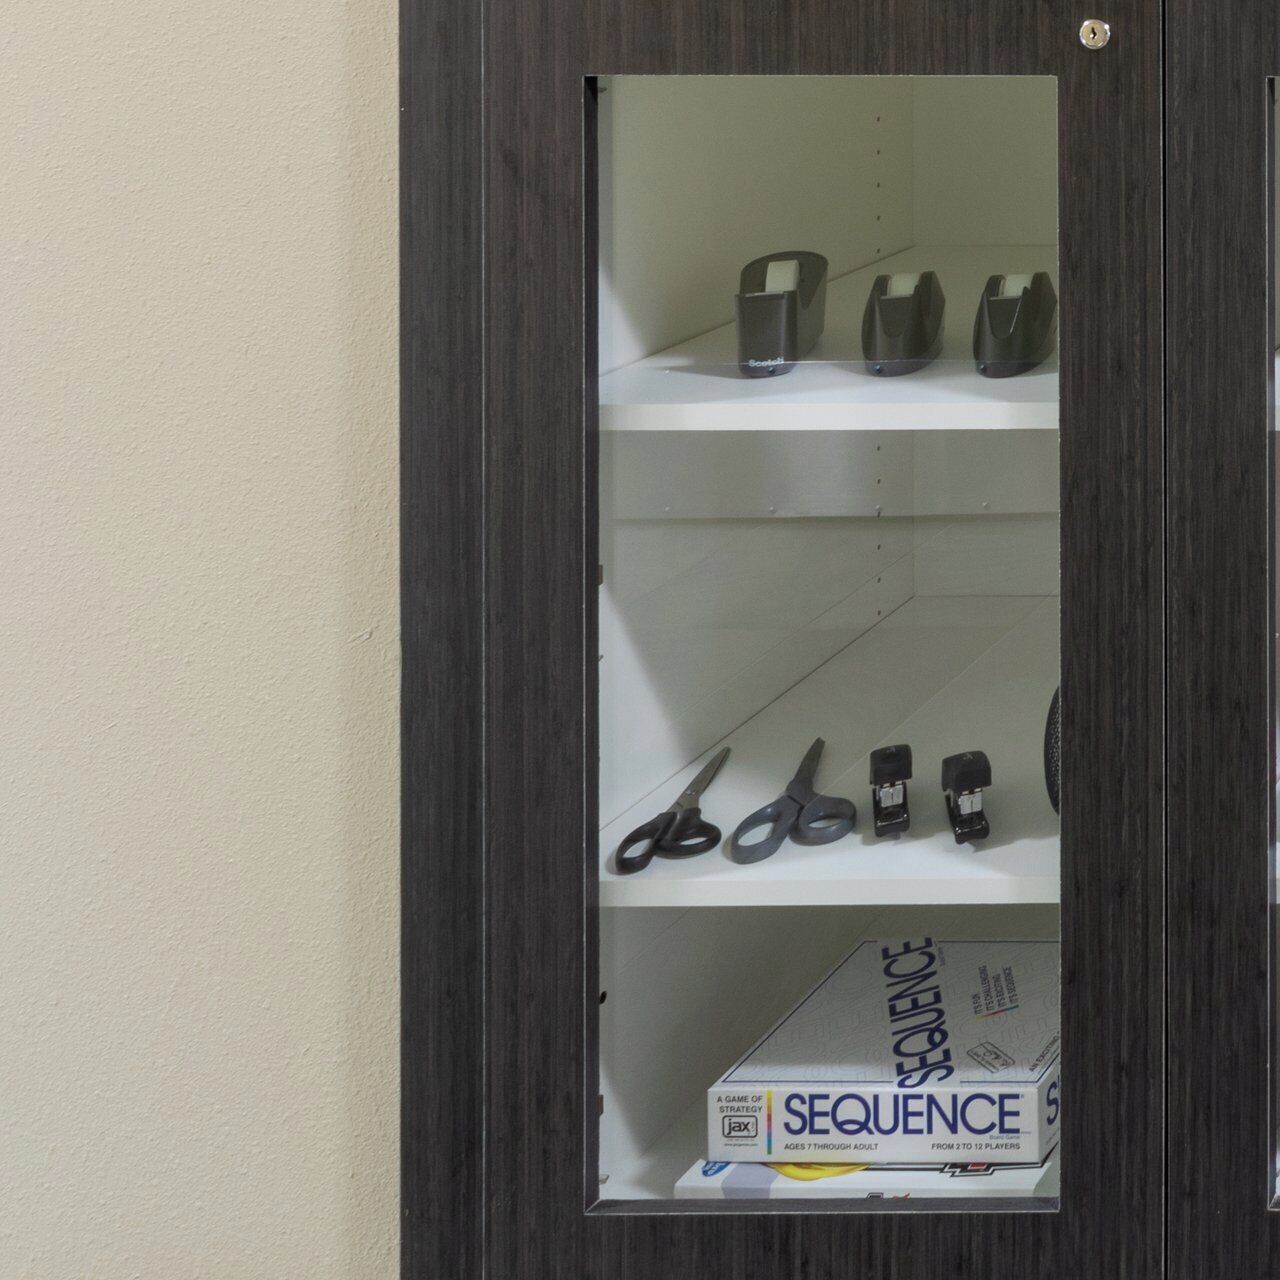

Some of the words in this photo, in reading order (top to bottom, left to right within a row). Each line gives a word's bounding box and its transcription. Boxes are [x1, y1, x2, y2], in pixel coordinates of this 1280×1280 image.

[748, 356, 785, 368] Scotch
[882, 936, 954, 1089] SEQUENCE
[719, 1105, 763, 1113] STRATEGY
[783, 1092, 1021, 1135] SEQUENCE
[726, 1118, 751, 1135] jax
[931, 1142, 954, 1150] FROM
[961, 1142, 973, 1150] TO
[974, 1142, 984, 1150] 12
[985, 1142, 1021, 1150] PLAYERS
